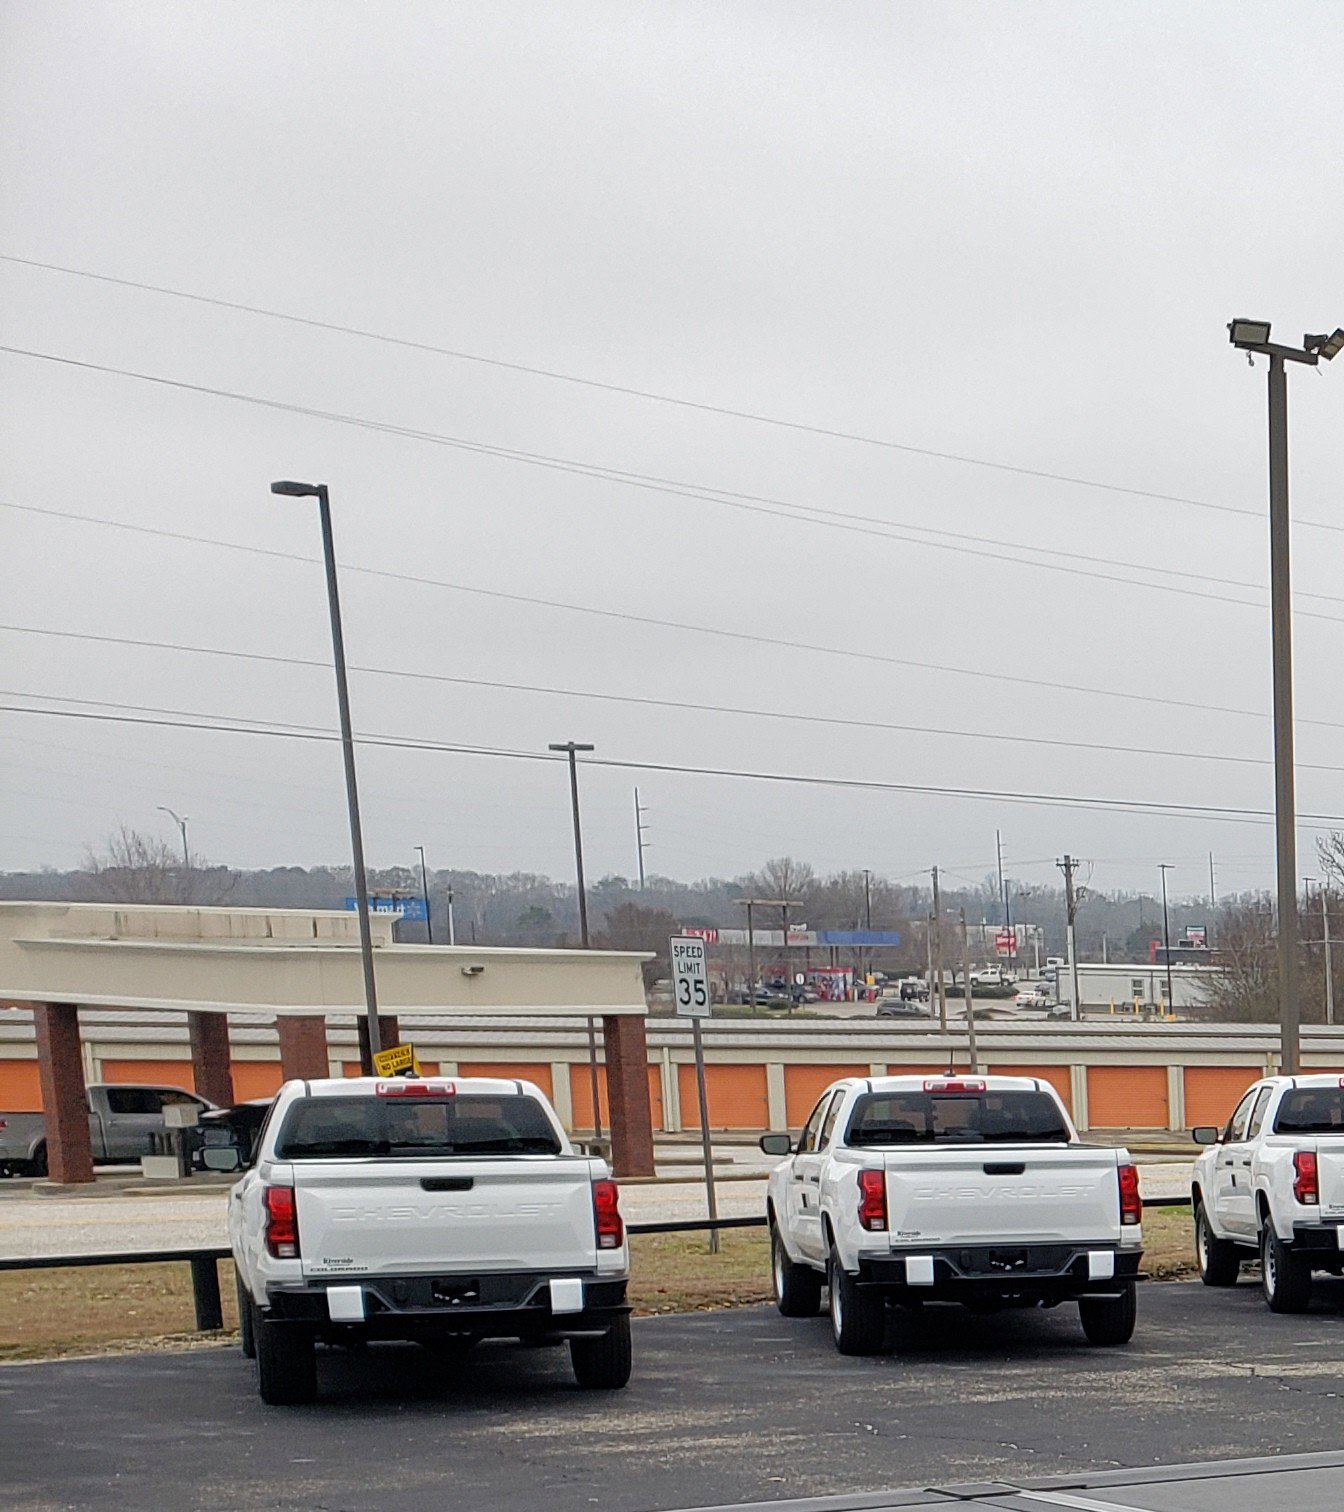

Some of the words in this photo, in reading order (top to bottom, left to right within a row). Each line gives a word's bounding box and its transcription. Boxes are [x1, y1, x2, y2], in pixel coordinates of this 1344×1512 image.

[674, 946, 703, 958] SPEED
[678, 962, 701, 975] LIMIT
[679, 978, 706, 1006] 35
[913, 1184, 1096, 1201] CHEVROLET
[330, 1202, 564, 1222] CHEVROLET
